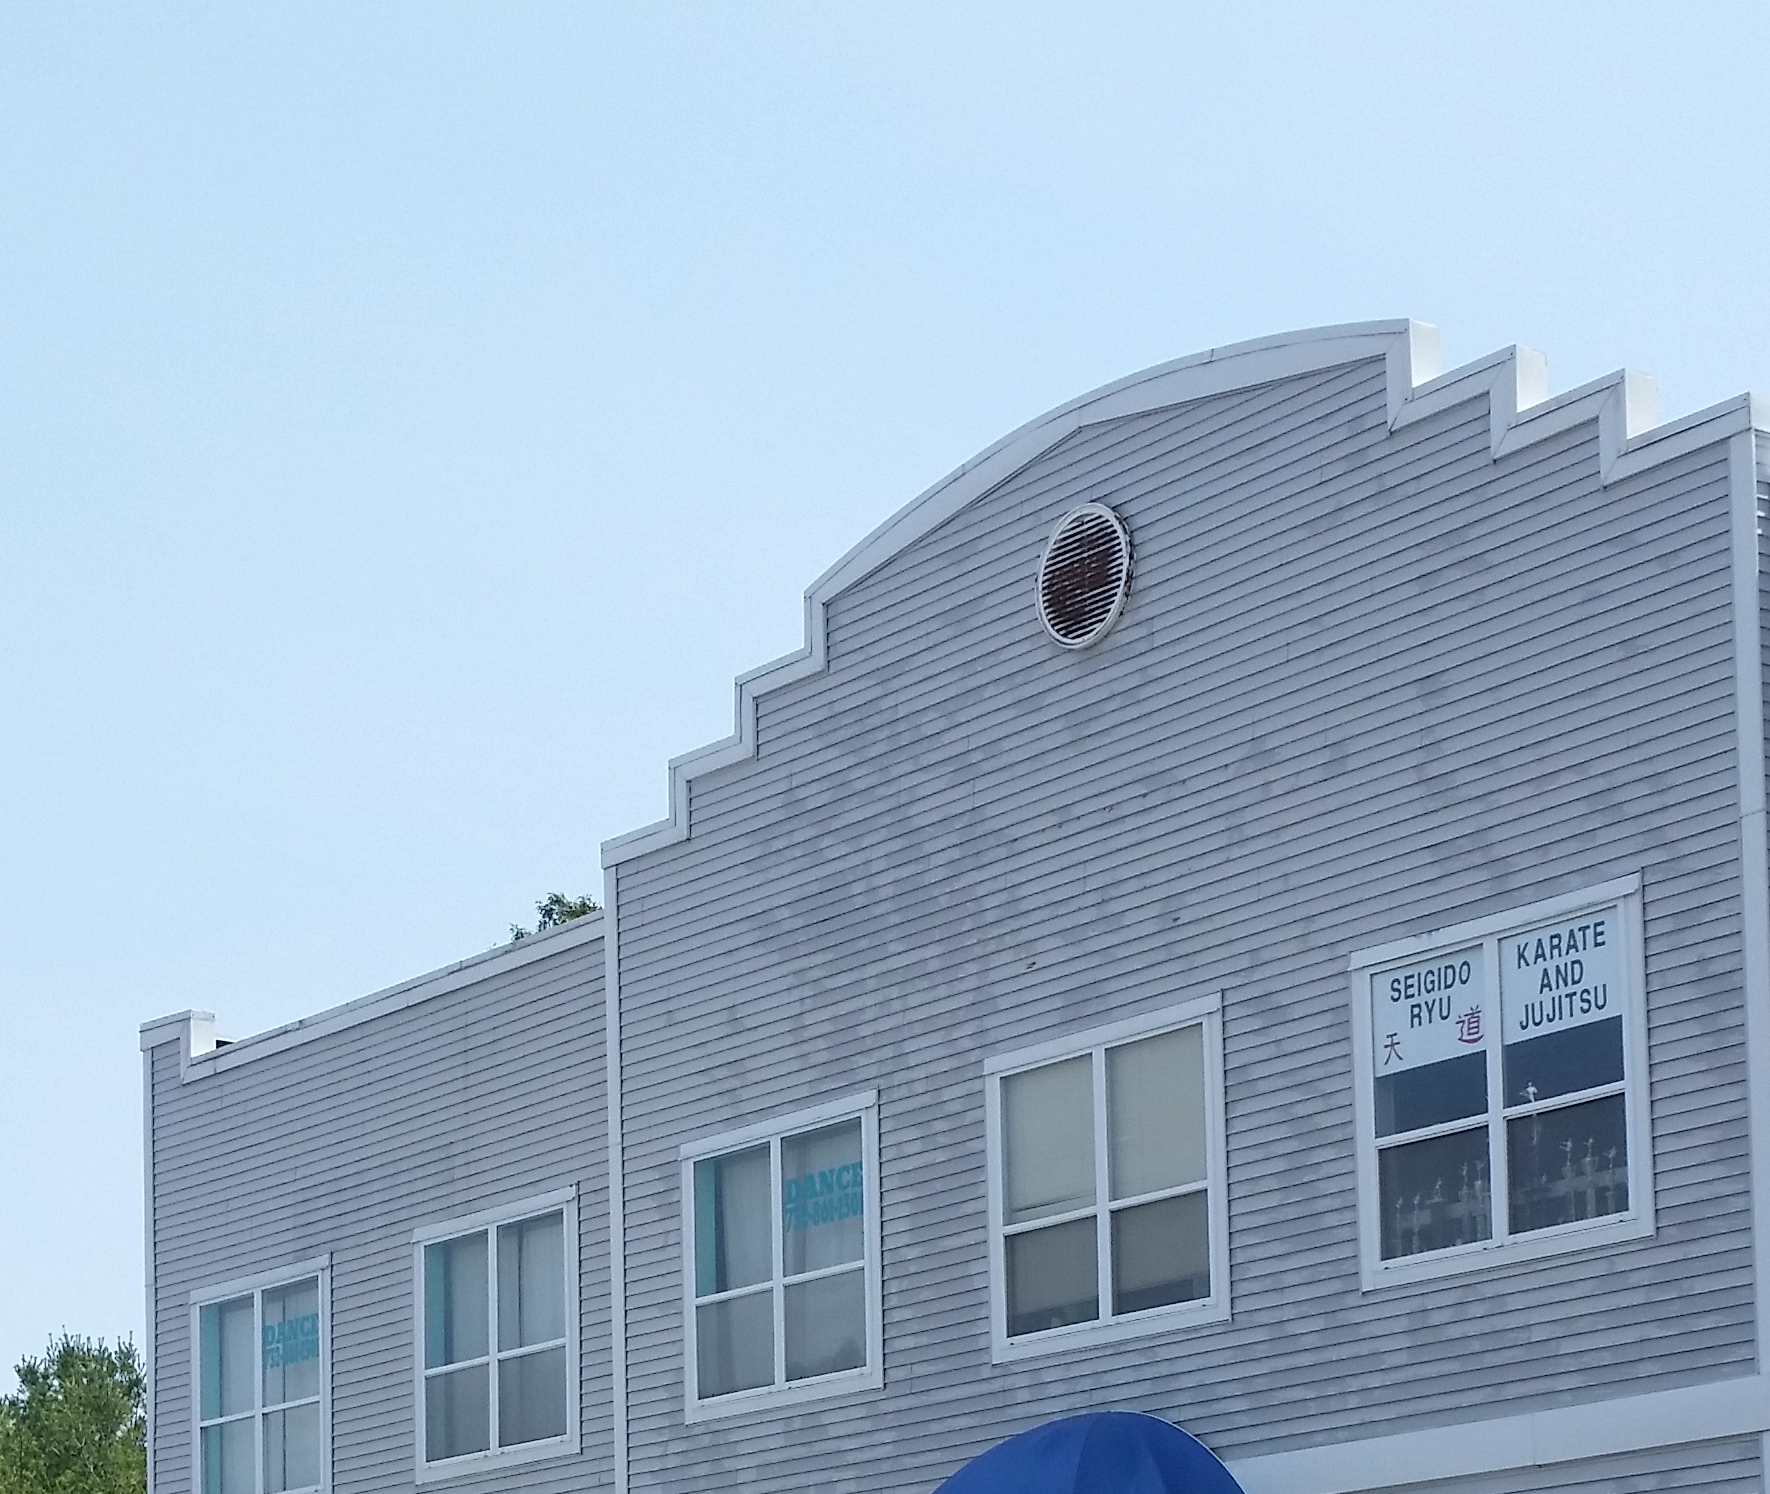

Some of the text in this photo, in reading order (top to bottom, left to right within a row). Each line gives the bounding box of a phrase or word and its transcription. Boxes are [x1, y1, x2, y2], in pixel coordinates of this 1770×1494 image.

[1516, 920, 1606, 969] KARATE
[1390, 960, 1472, 1002] SEIGIDO
[1539, 959, 1584, 995] AND
[1410, 996, 1451, 1028] RYU
[1519, 984, 1608, 1031] JUJITSU
[1384, 1005, 1485, 1065] 天 道
[786, 1162, 863, 1204] DANCE
[264, 1313, 318, 1346] DANCE
